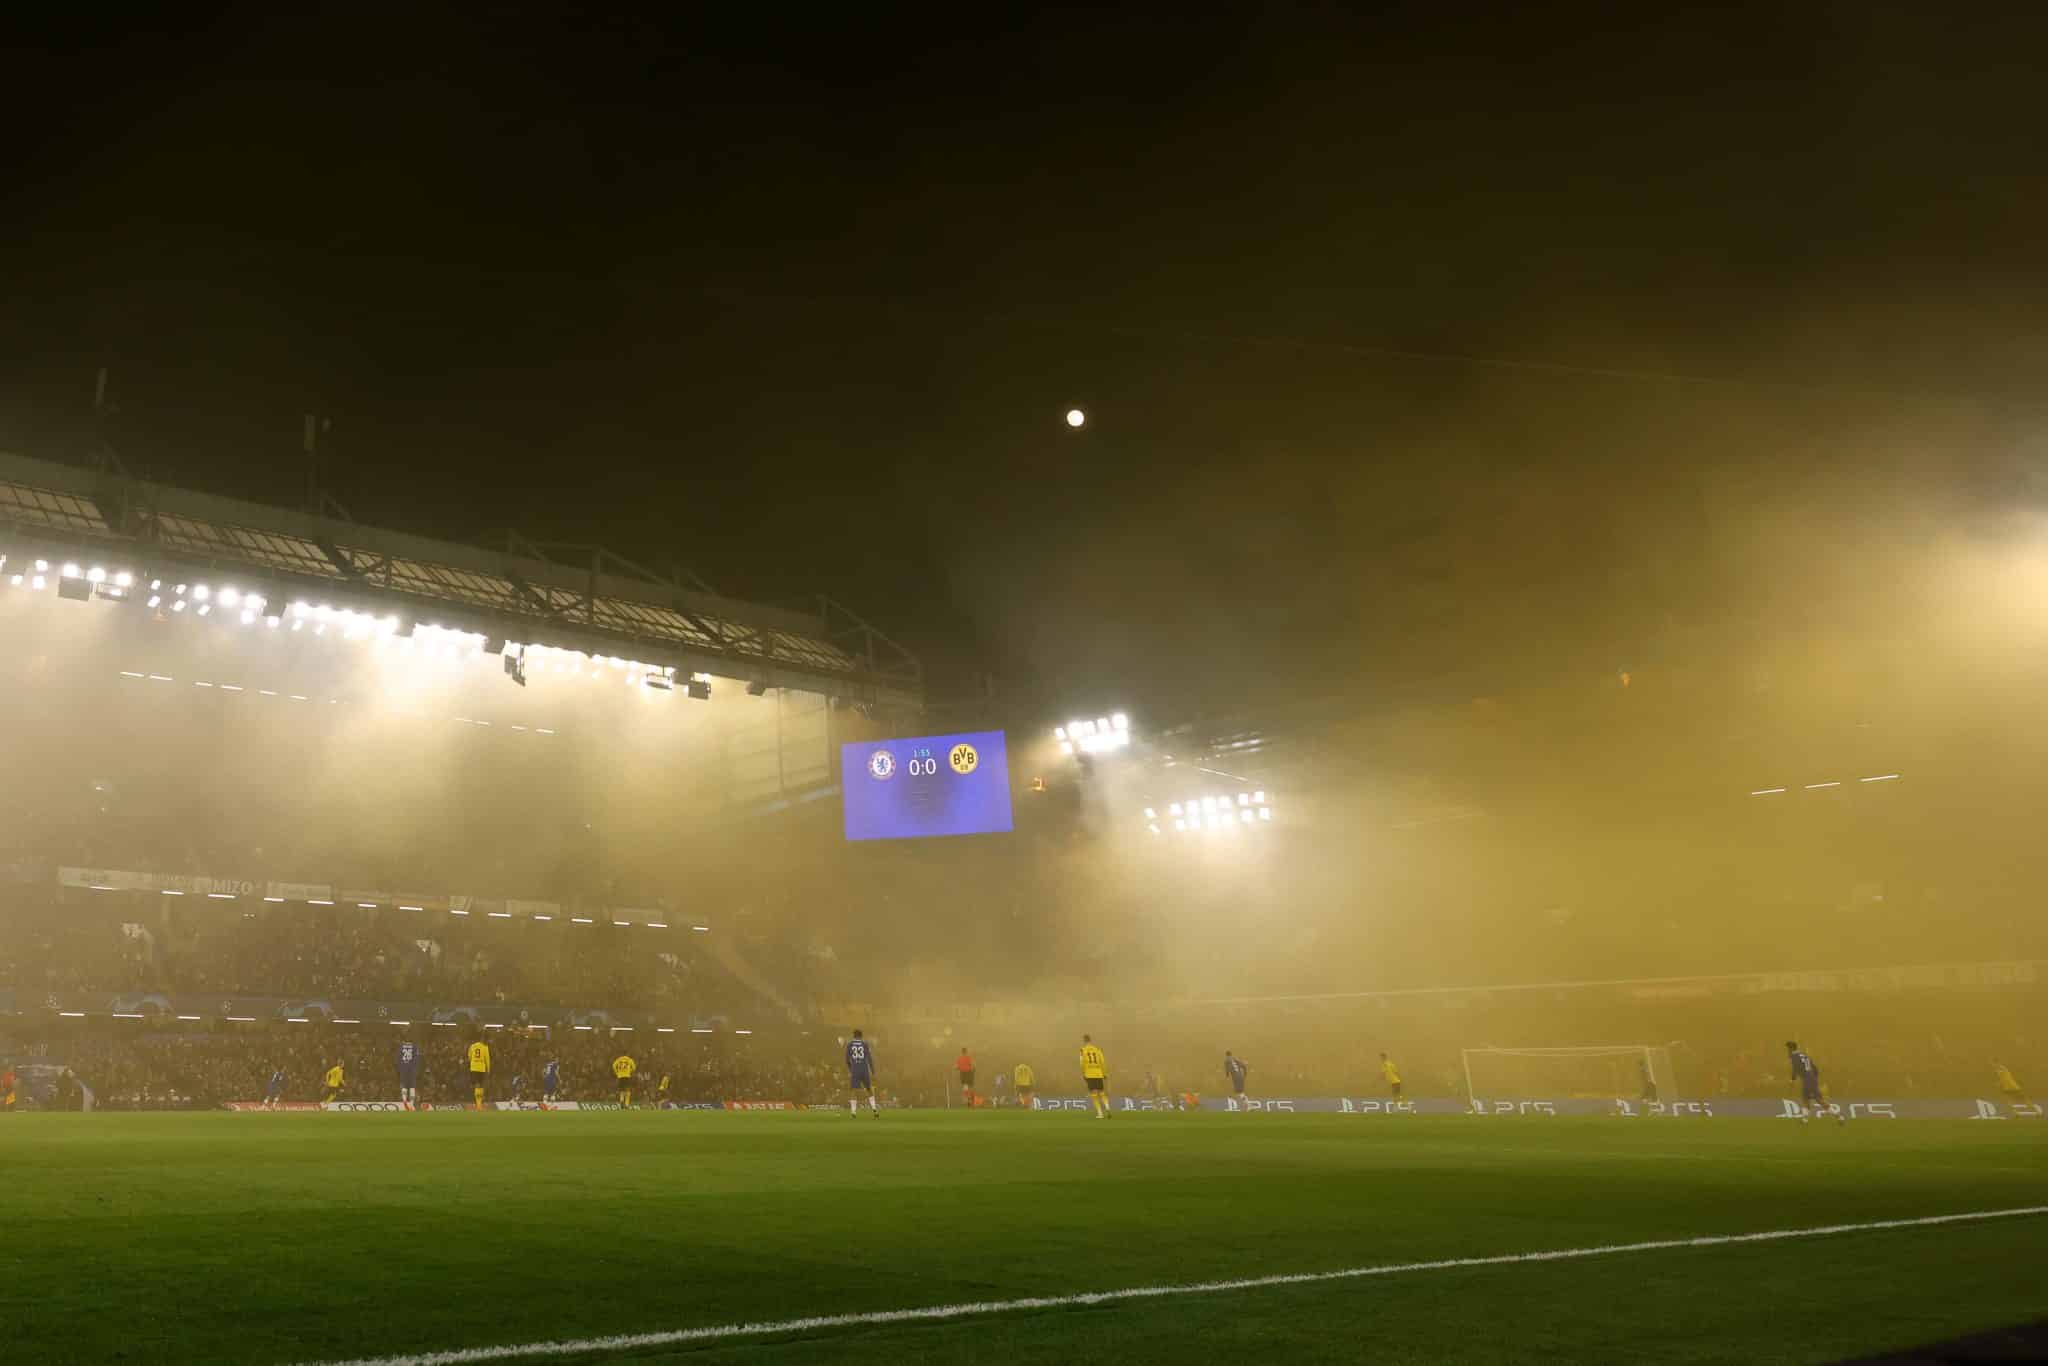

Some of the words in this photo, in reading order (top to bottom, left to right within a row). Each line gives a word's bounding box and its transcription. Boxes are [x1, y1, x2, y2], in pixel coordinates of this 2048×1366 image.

[953, 747, 974, 764] BVB
[909, 758, 936, 775] 0:0
[851, 1046, 865, 1059] 33
[1087, 1052, 1098, 1064] 11
[1047, 1099, 1088, 1111] PS5
[1248, 1100, 1294, 1112] PS5
[1494, 1102, 1557, 1115] PS5
